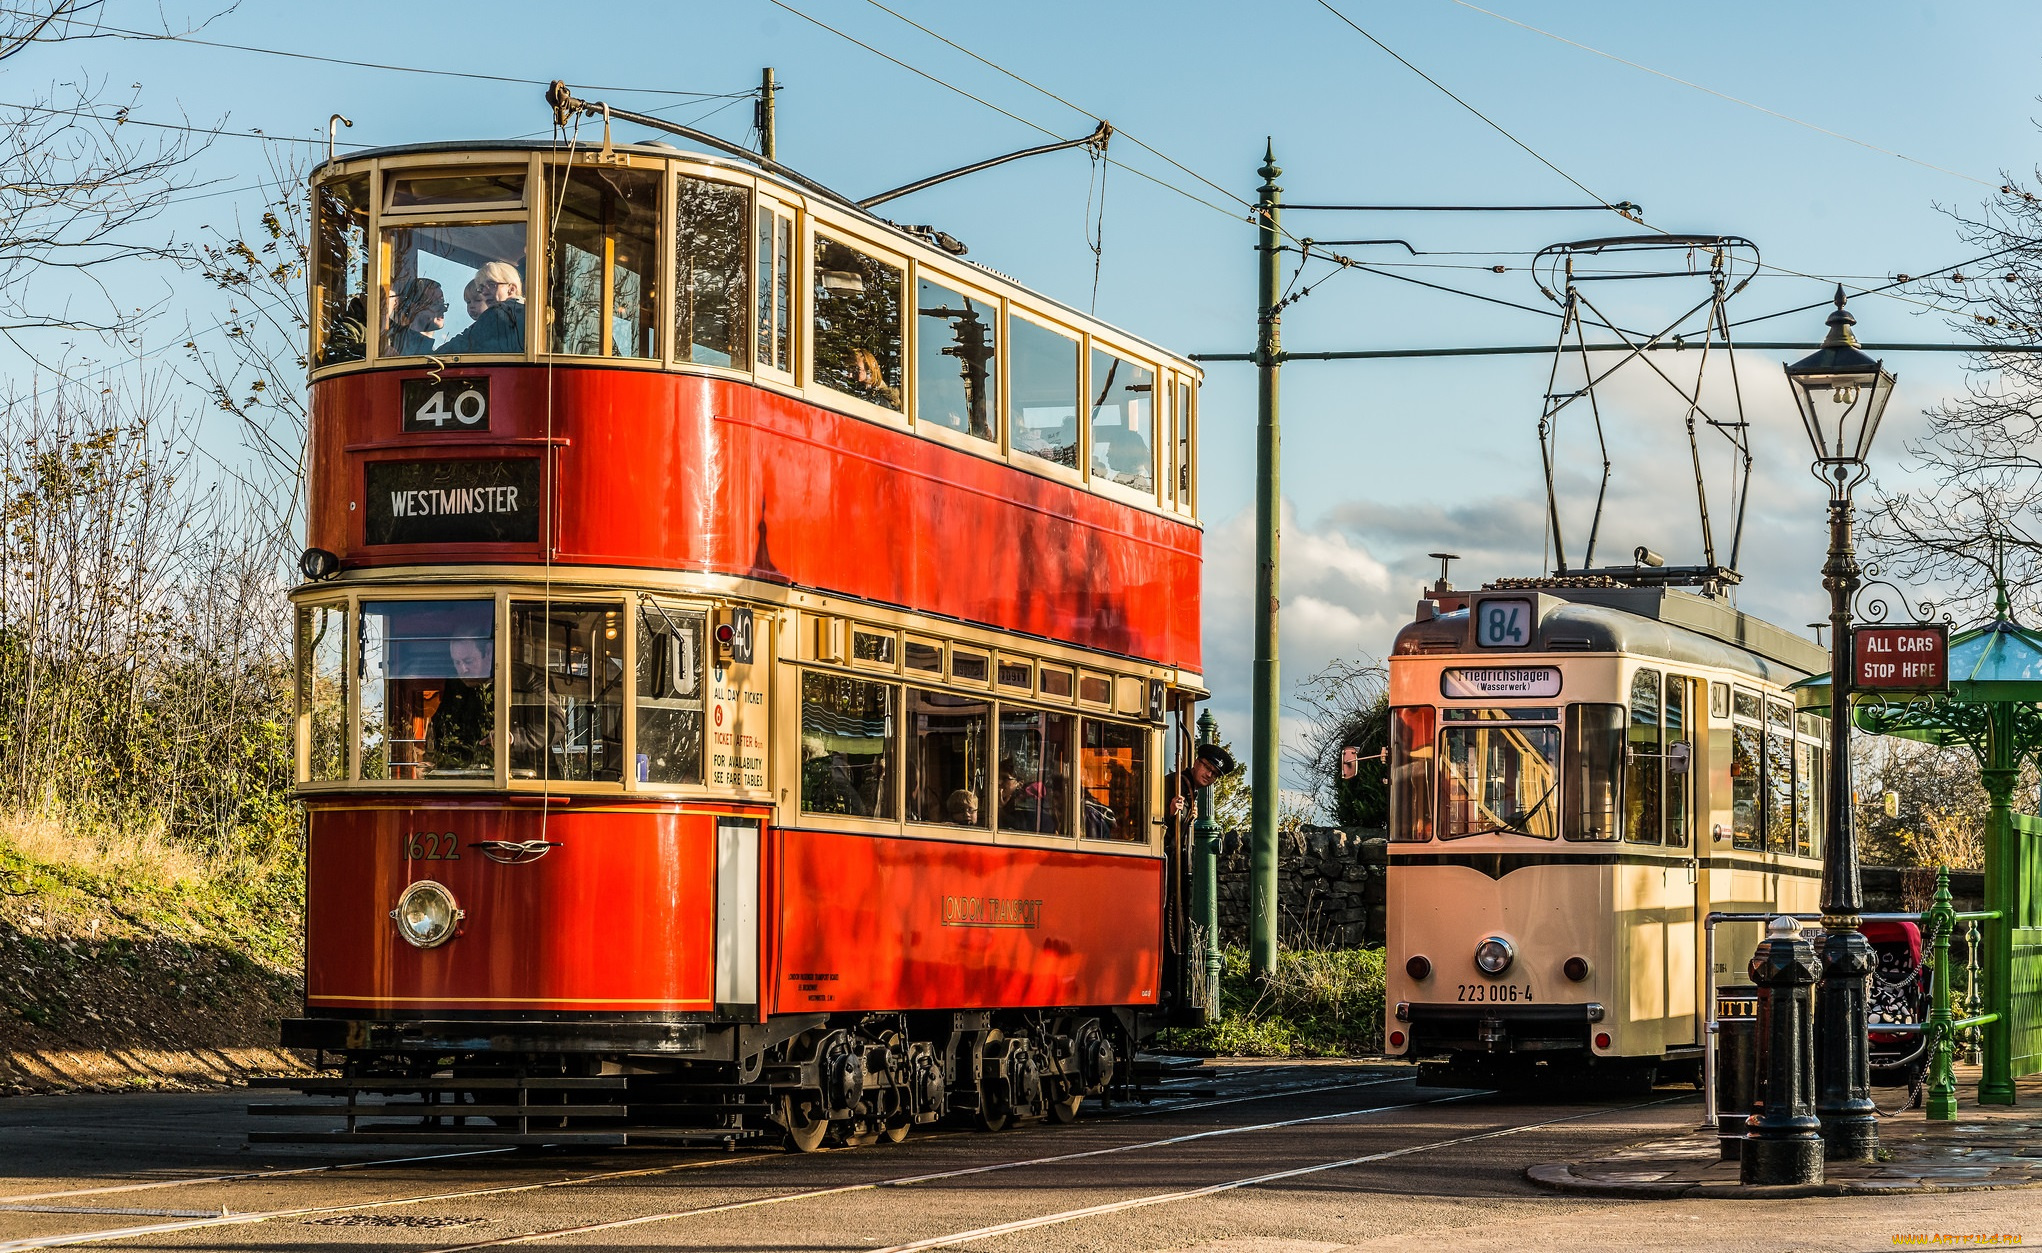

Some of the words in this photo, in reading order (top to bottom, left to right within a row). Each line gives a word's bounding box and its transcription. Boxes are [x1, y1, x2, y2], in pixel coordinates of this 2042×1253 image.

[416, 390, 486, 427] 40
[391, 486, 518, 517] WESTMINSTER
[1489, 608, 1522, 642] 84
[733, 614, 752, 658] 40
[1867, 636, 1892, 652] ALL
[1897, 636, 1934, 652] CARS
[1459, 670, 1550, 683] Friedrichshagen
[1864, 662, 1896, 678] STOP
[1902, 662, 1936, 678] HERE
[1477, 682, 1531, 691] (Wasserwerk)
[714, 688, 724, 700] ALL
[728, 689, 740, 702] DAY
[744, 691, 763, 705] TICKET
[1150, 684, 1164, 718] 40
[1712, 686, 1722, 713] 84
[714, 732, 733, 746] TICKET
[736, 734, 752, 747] AFTER
[714, 754, 725, 767] FOR
[728, 755, 763, 770] AVAILABILITY
[714, 771, 723, 783] SEE
[726, 773, 741, 786] FARE
[744, 774, 763, 787] TABLES
[403, 832, 460, 860] 1622
[941, 895, 984, 926] LONDON
[989, 898, 1042, 928] TRANSPORT
[1457, 984, 1484, 1001] 223
[1489, 984, 1533, 1001] 006-4
[1719, 1001, 1757, 1016] ITT
